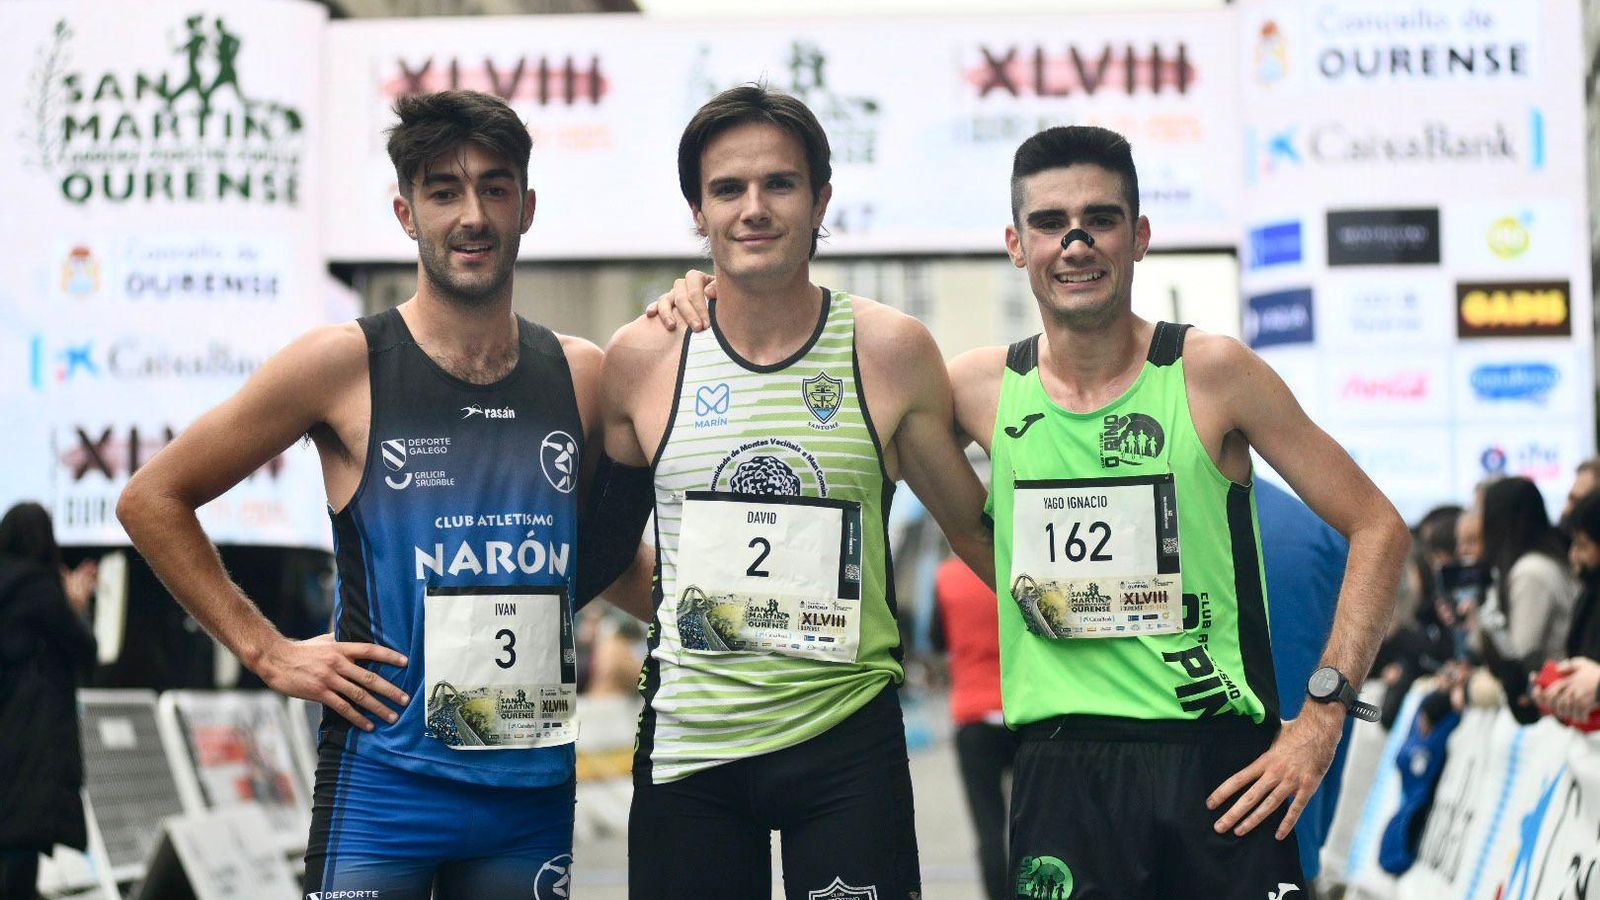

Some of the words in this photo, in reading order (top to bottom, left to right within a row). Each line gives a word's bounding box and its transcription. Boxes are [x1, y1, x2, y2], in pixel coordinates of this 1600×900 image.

[1319, 45, 1527, 77] OURENSE
[980, 44, 1189, 97] XLVIII
[63, 72, 168, 102] SAN
[1311, 119, 1516, 162] CaixaBank
[61, 171, 299, 203] OURENSE
[126, 273, 279, 295] OURENSE
[485, 406, 516, 419] rasán
[694, 416, 728, 429] MARÍN
[408, 437, 451, 446] DEPORTE
[740, 439, 769, 452] Montes
[409, 446, 448, 455] GALEGO
[414, 470, 446, 479] GALICIA
[415, 478, 455, 487] SAUDABLE
[1043, 497, 1065, 510] YAGO
[1067, 495, 1108, 509] IGNACIO
[434, 514, 474, 529] CLUB
[477, 513, 553, 527] ATLETISMO
[747, 511, 777, 525] DAVID
[1045, 521, 1113, 562] 162
[414, 529, 570, 580] NARÓN
[746, 537, 771, 577] 2
[1123, 590, 1169, 605] XLVIII
[495, 603, 517, 616] IVAN
[1071, 605, 1111, 613] OURENSE
[1200, 592, 1212, 629] CLUB
[748, 621, 789, 630] OURENSE
[802, 612, 846, 628] XLVIII
[495, 628, 517, 669] 3
[542, 699, 568, 713] XLVIII
[325, 890, 379, 900] DEPORTE
